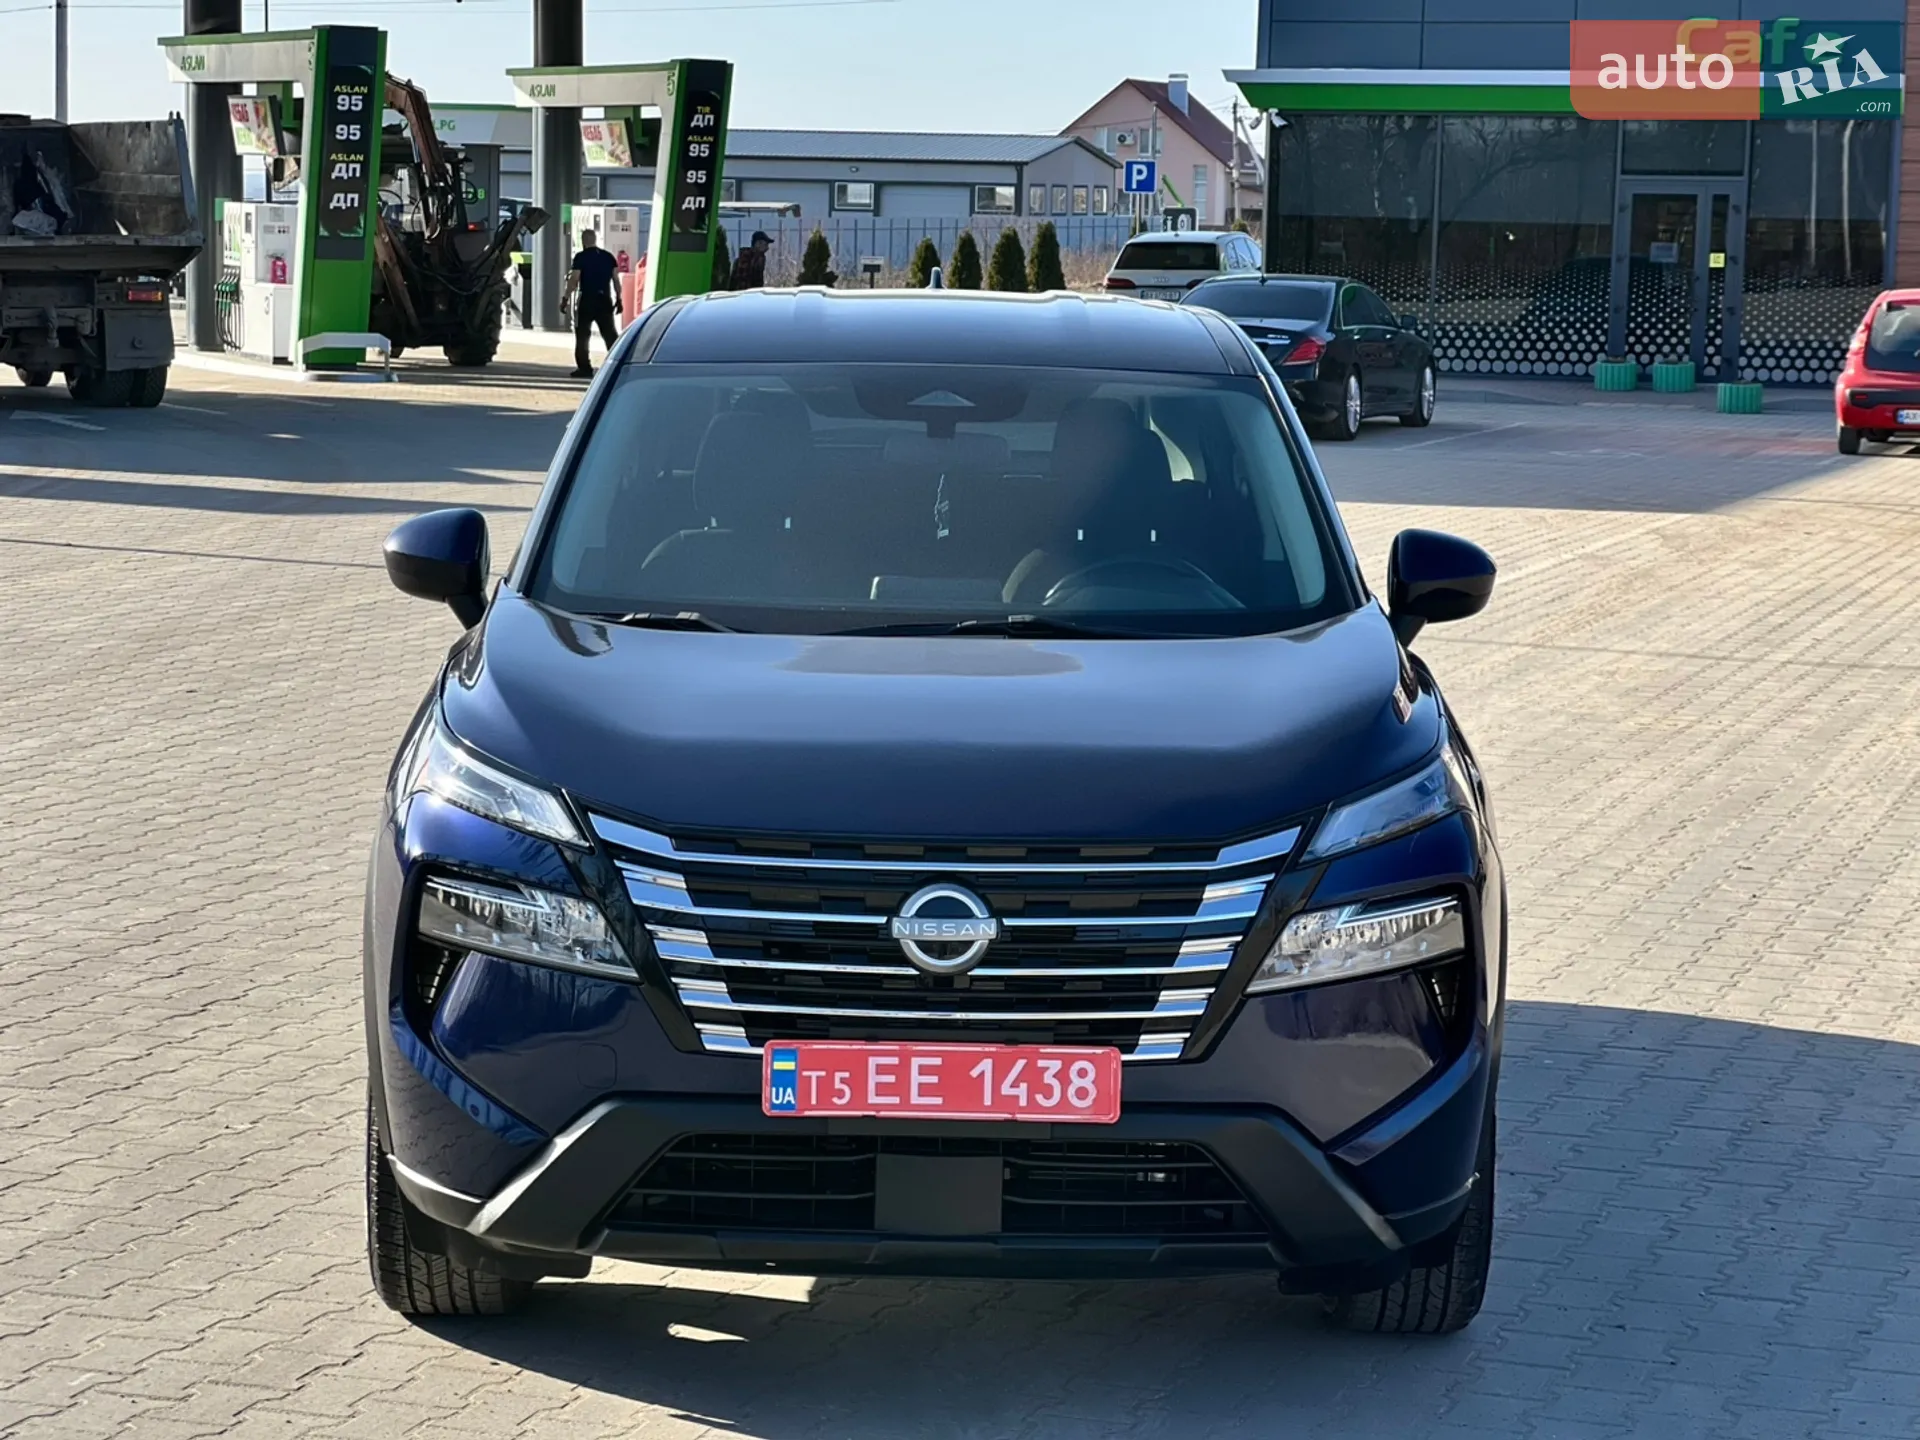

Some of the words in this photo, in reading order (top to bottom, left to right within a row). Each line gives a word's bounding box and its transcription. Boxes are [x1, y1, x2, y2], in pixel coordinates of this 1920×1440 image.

[333, 85, 368, 94] ASLAN
[336, 95, 363, 111] 95
[690, 114, 714, 128] ДП
[335, 124, 361, 140] 95
[330, 153, 364, 161] ASLAN
[688, 143, 710, 157] 95
[331, 163, 361, 180] ДП
[686, 170, 707, 183] 95
[1131, 163, 1148, 190] P
[329, 193, 359, 210] ДП
[682, 196, 706, 210] ДП
[894, 922, 995, 936] NISSAN
[802, 1070, 852, 1106] T5
[867, 1056, 944, 1105] EE
[969, 1058, 1098, 1109] 1438
[771, 1087, 796, 1105] UA
